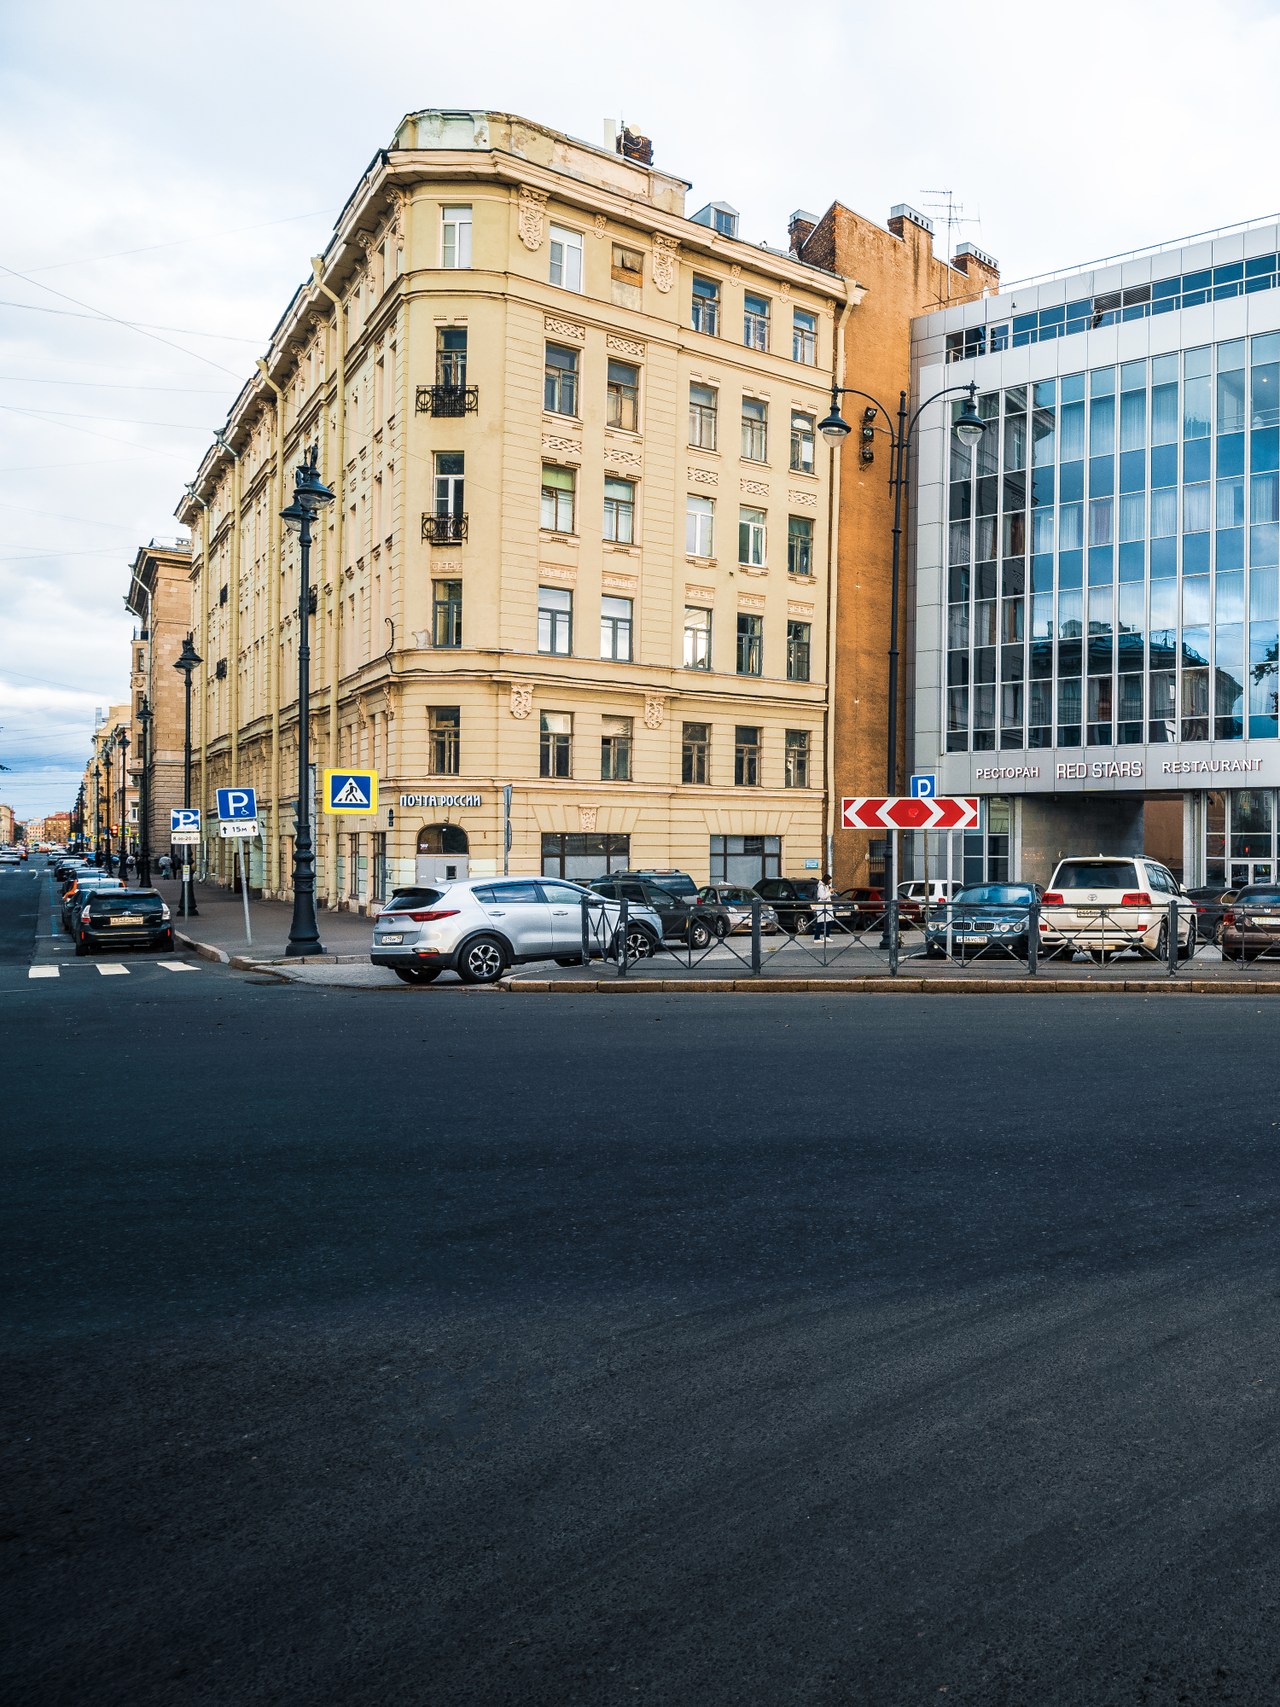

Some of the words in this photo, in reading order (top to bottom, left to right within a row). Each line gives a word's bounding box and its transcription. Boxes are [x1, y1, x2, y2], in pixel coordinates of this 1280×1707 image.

[1056, 762, 1088, 780] RED
[1092, 760, 1143, 779] STARS
[1162, 758, 1263, 774] RESTAURANT
[976, 767, 1040, 780] РЕСТОРАН
[400, 794, 438, 807] ПОЧТА
[440, 794, 481, 807] РОССИИ
